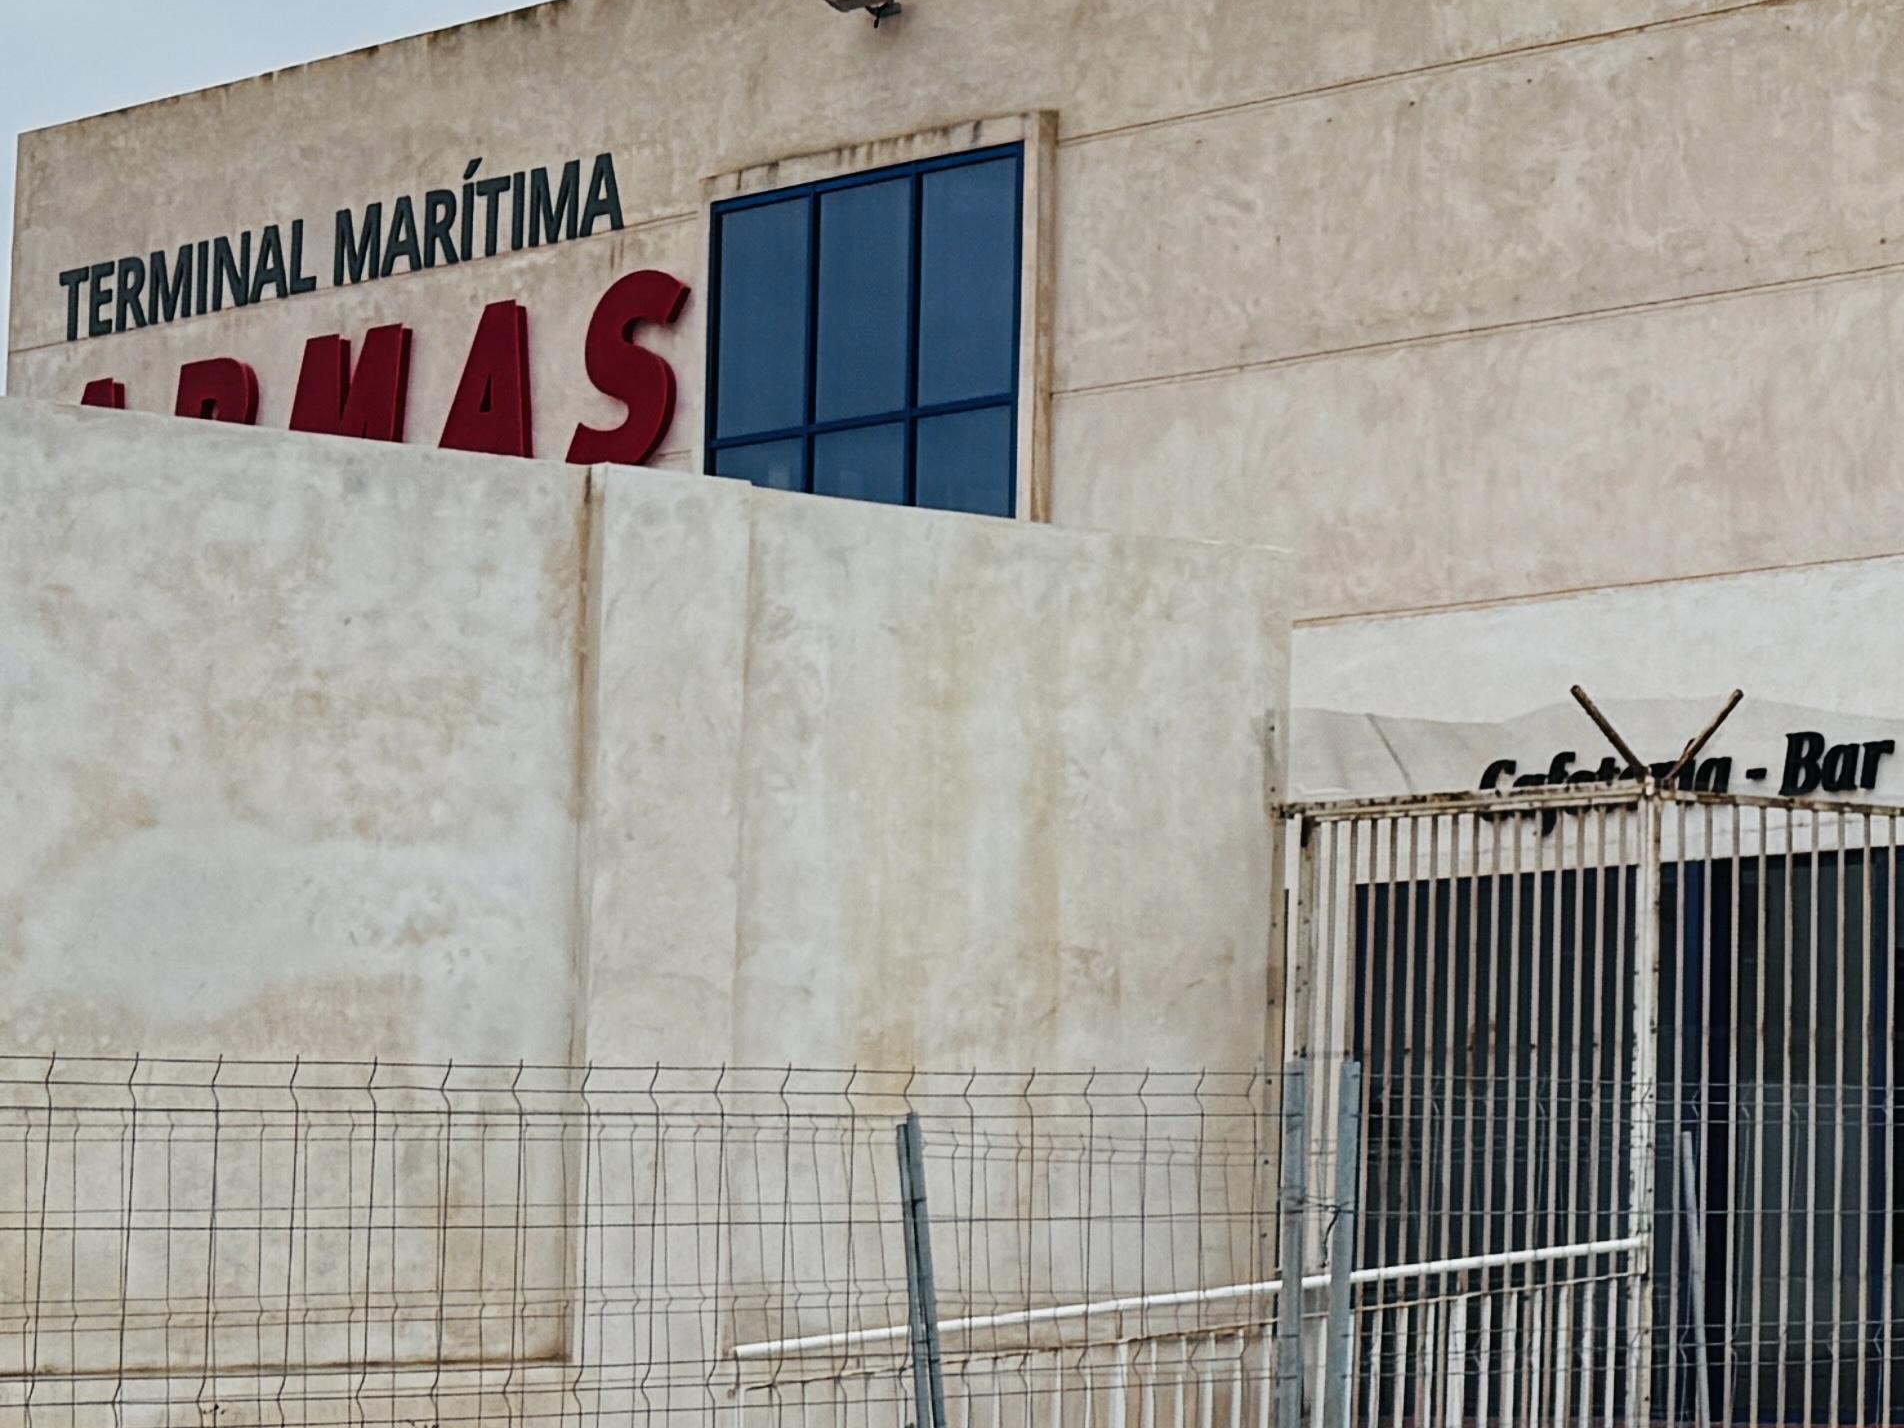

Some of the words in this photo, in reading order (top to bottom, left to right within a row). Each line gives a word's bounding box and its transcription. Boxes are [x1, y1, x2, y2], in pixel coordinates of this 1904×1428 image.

[58, 218, 317, 342] TERMINAL
[333, 152, 625, 287] MARÍTIMA
[80, 268, 692, 466] MAS
[1778, 730, 1896, 797] Bar
